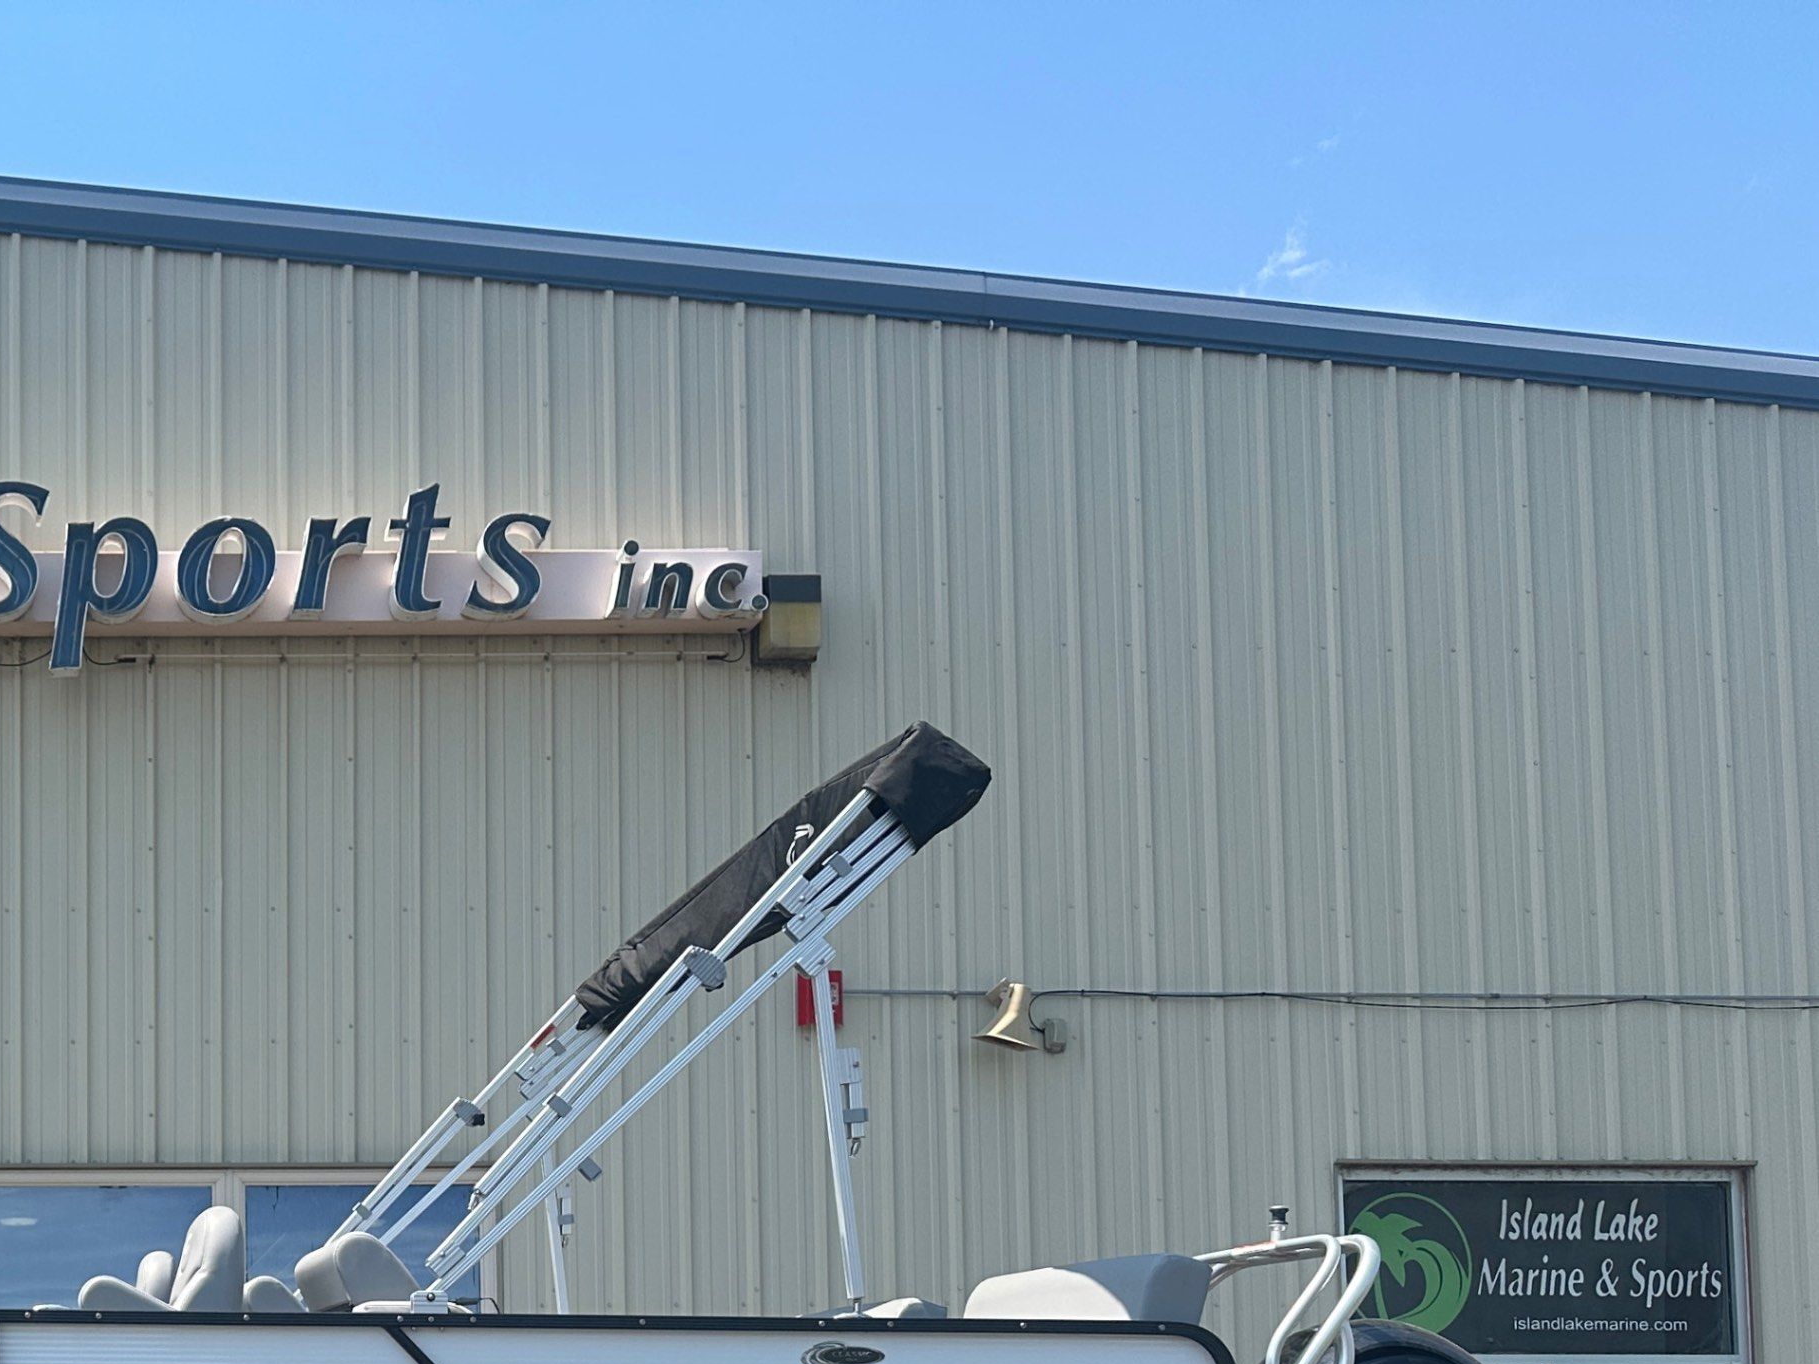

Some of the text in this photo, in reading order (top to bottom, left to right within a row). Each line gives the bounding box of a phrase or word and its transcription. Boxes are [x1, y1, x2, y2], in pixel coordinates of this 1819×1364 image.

[605, 539, 769, 619] inc.
[1499, 1197, 1659, 1242] Island Lake
[1477, 1254, 1722, 1308] Marine & Sports
[1513, 1317, 1688, 1332] islandlakemarine.com
